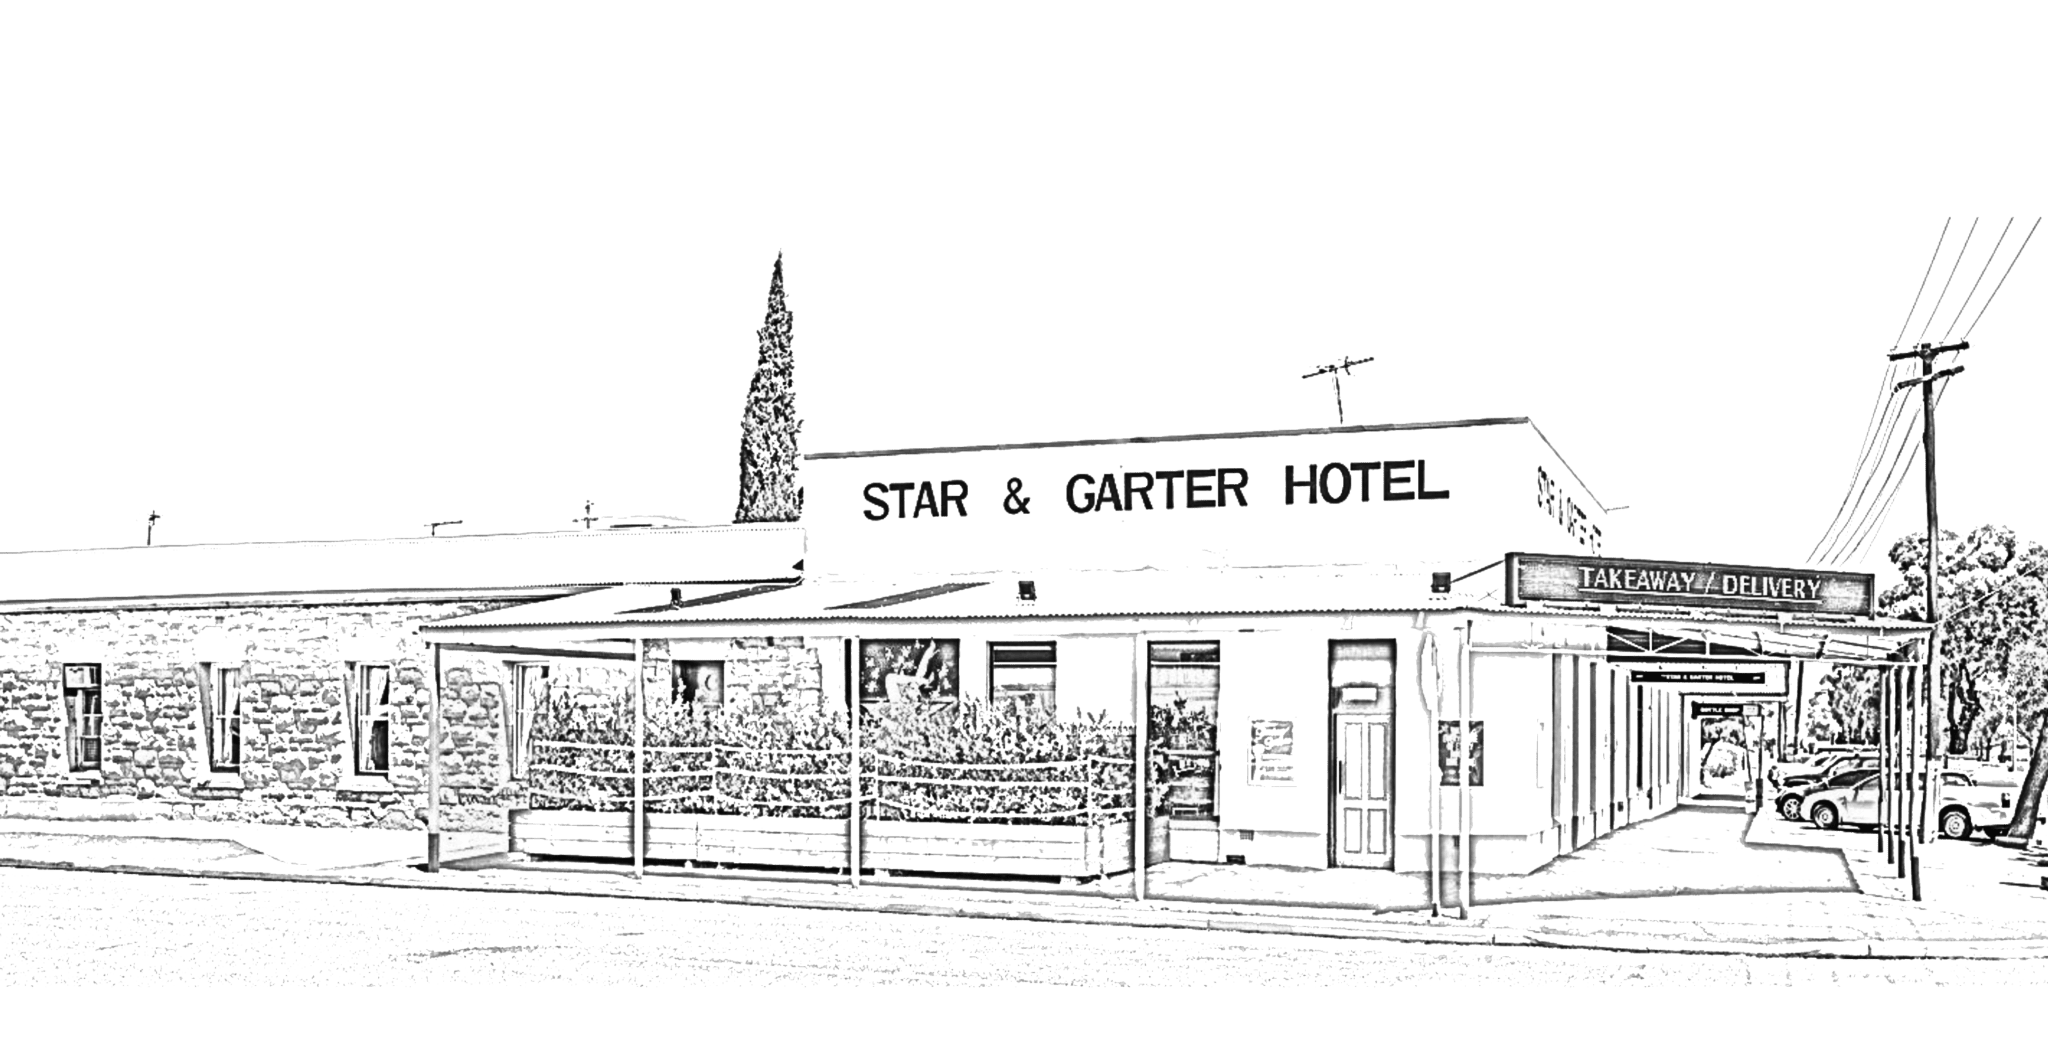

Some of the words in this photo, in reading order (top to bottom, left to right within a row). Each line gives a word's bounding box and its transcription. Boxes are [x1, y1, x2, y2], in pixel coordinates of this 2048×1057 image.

[863, 479, 970, 522] STAR
[1002, 476, 1033, 515] &
[1065, 466, 1250, 514] GARTER
[1284, 459, 1451, 505] HOTEL
[1578, 566, 1696, 591] TAKEAWAY
[1722, 574, 1822, 599] DELIVERY
